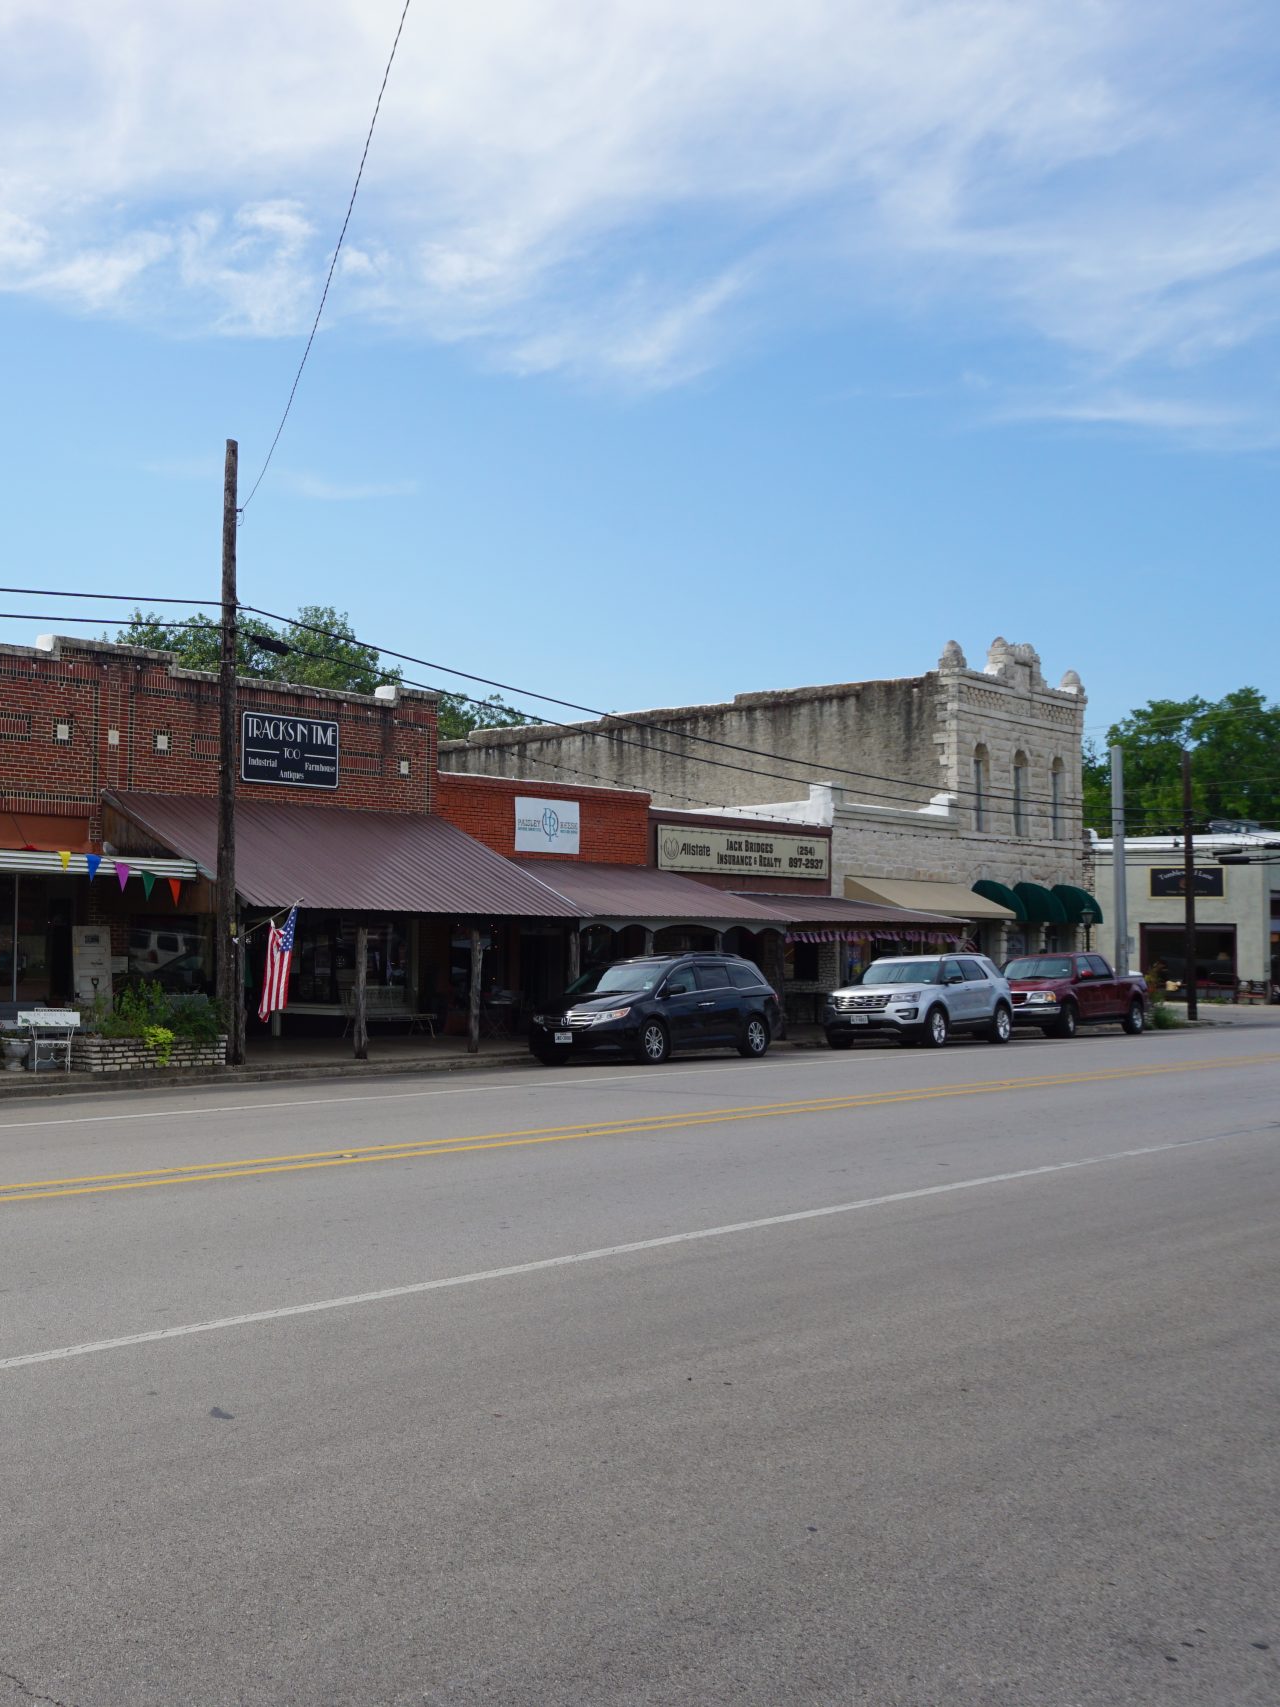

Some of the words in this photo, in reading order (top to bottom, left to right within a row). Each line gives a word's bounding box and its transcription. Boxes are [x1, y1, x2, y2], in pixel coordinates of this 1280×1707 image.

[246, 717, 295, 742] TRACKS
[297, 723, 309, 743] IN
[311, 725, 337, 747] TIME
[283, 747, 301, 760] TOO
[248, 757, 278, 768] Industrial
[304, 762, 336, 773] Farmhouse
[279, 769, 304, 781] Antiques
[680, 843, 711, 857] Allstate
[726, 838, 743, 852] JACK
[744, 840, 774, 854] BRIDGES
[796, 845, 816, 857] (254)
[717, 852, 753, 866] INSURANCE
[759, 855, 782, 868] REALTY
[788, 857, 824, 870] 897-2937
